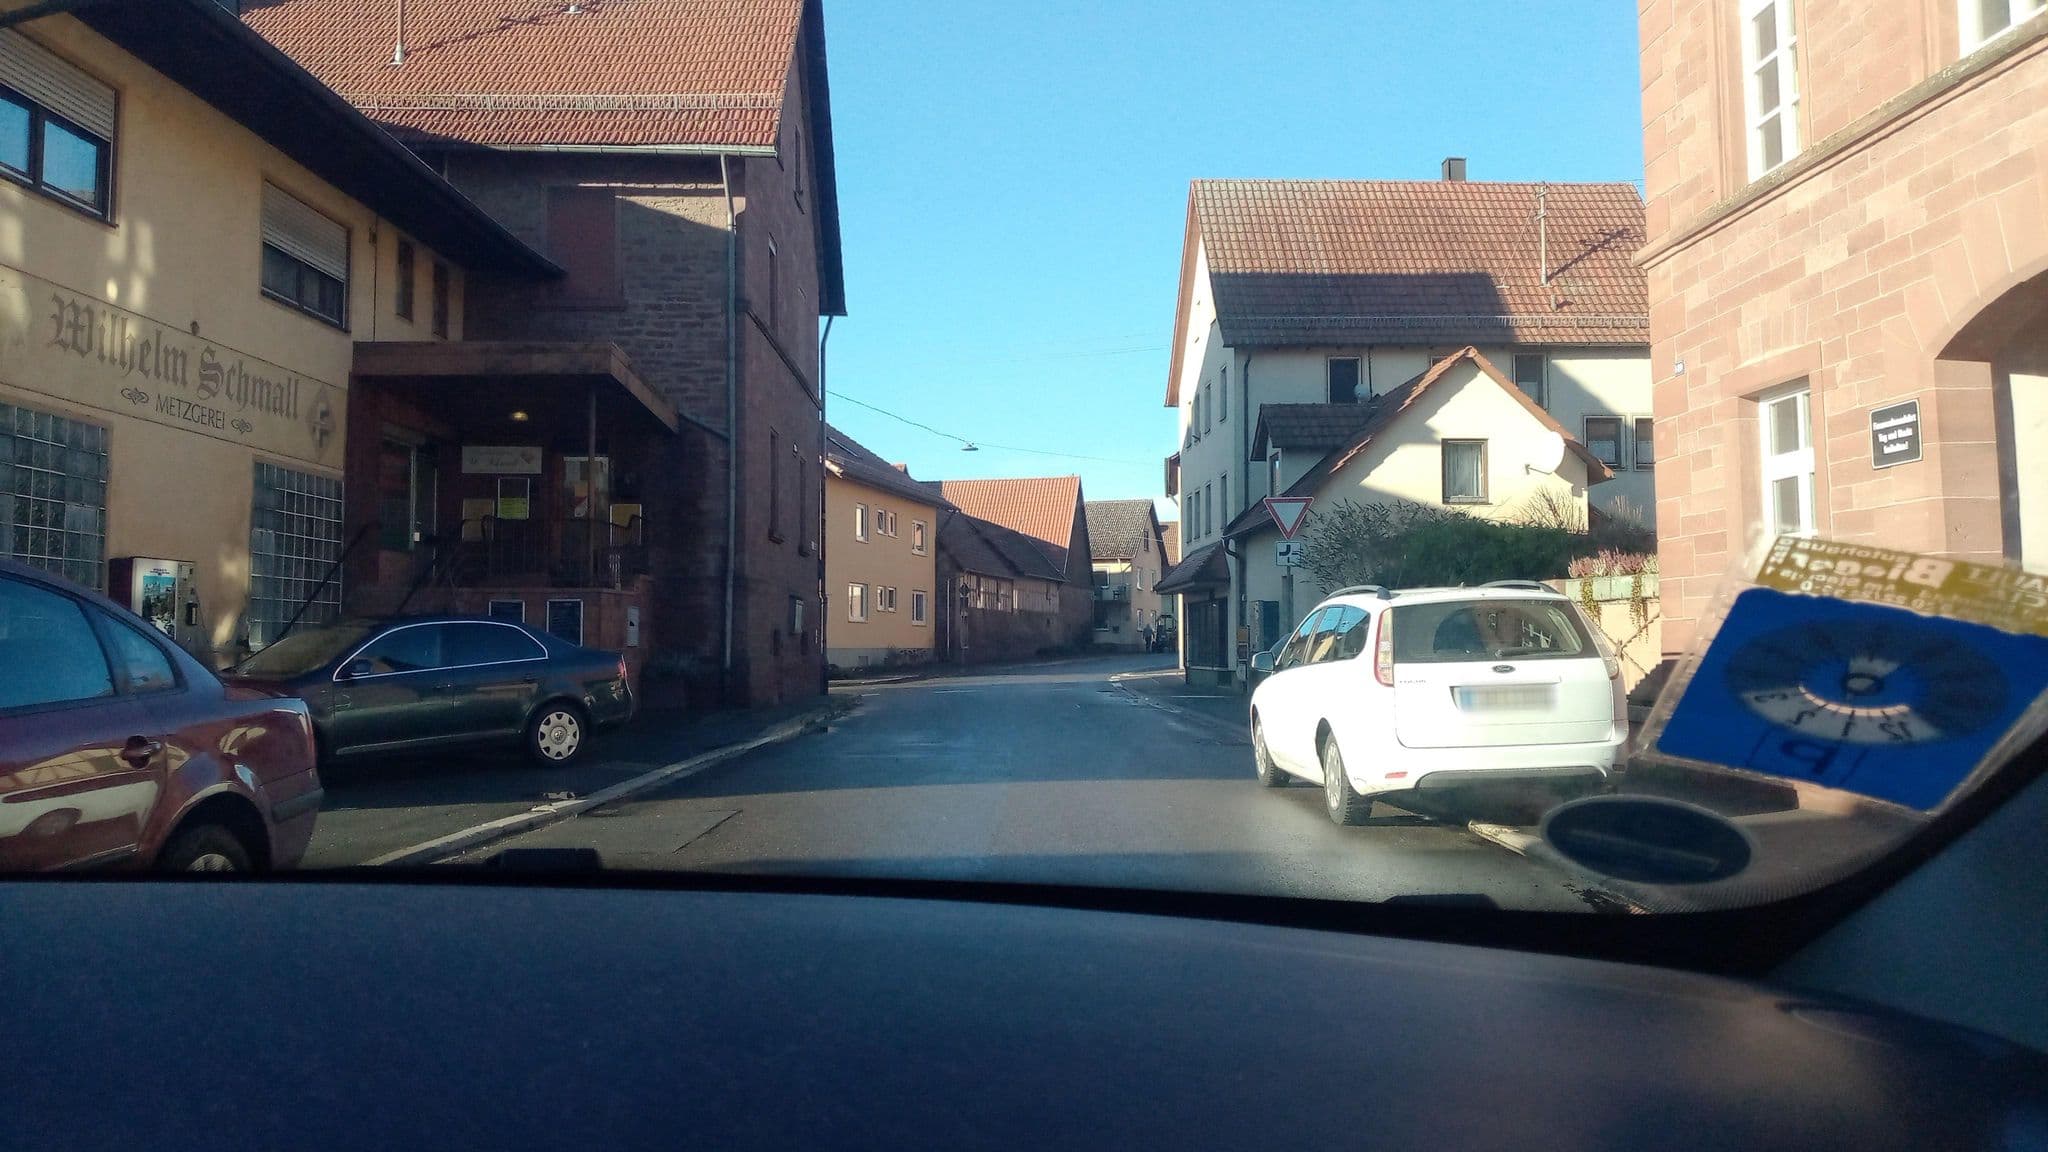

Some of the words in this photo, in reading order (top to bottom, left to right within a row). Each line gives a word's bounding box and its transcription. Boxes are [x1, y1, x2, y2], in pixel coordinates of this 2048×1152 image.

[50, 292, 188, 387] Wilhelm
[197, 345, 300, 420] Schmall
[155, 394, 225, 431] METZGEREI
